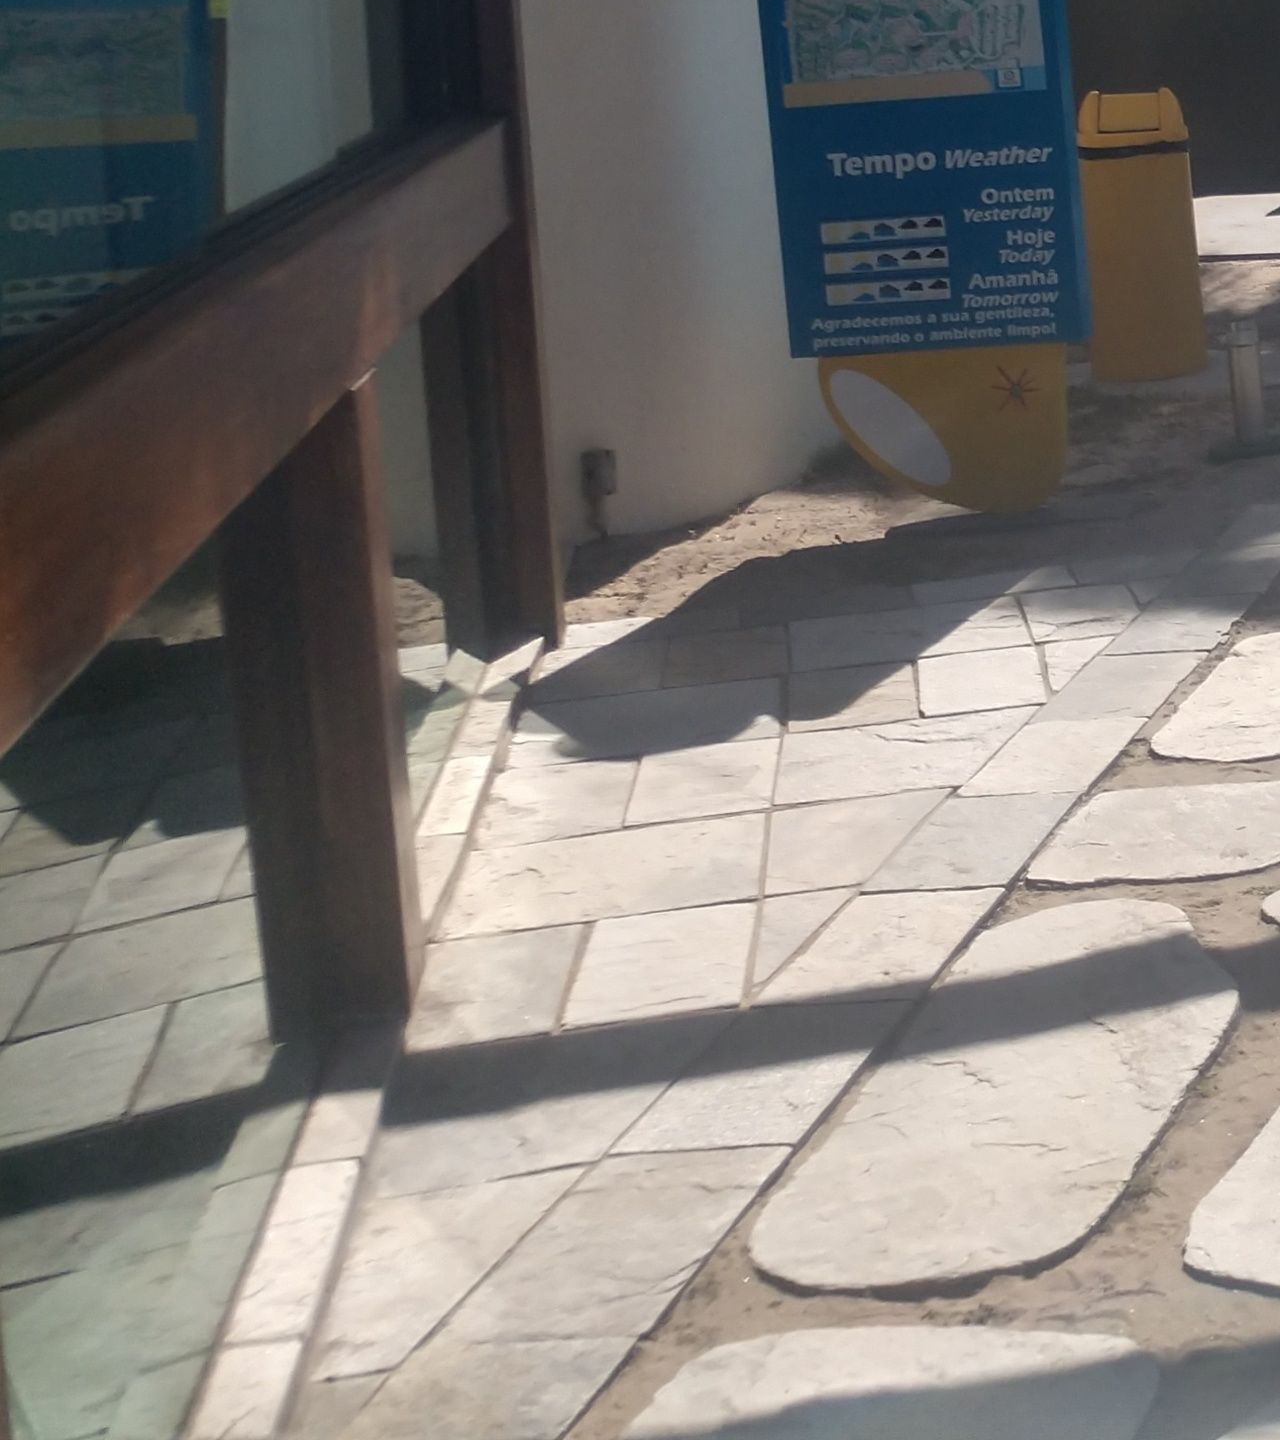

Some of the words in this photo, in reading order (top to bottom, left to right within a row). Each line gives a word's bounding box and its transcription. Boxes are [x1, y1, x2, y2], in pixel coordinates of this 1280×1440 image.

[826, 149, 937, 179] Tempo
[944, 145, 1054, 169] Weather
[980, 186, 1055, 205] Ontem
[962, 203, 1055, 223] Yesterday
[1006, 228, 1056, 250] Hoje
[999, 247, 1056, 266] Today
[968, 269, 1059, 290] Amanhã
[962, 290, 1060, 309] Tomorrow
[811, 312, 923, 333] Agradecemos
[926, 312, 937, 323] a
[941, 309, 970, 323] sua
[812, 332, 911, 352] preservando
[913, 332, 925, 343] o
[928, 326, 1003, 343] ambiente
